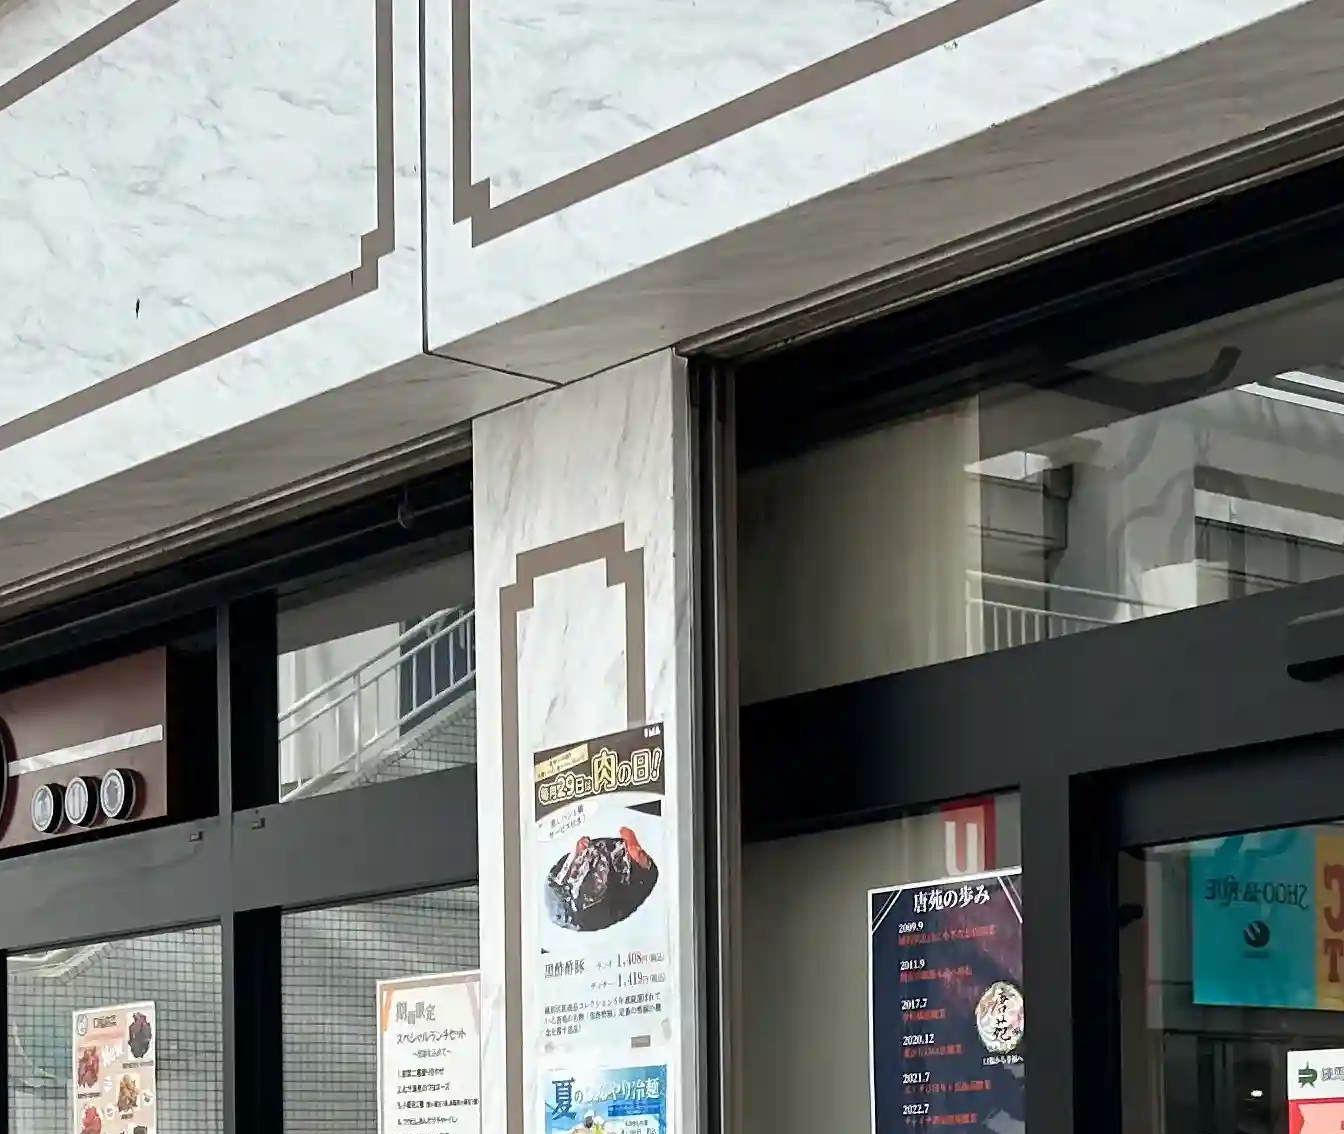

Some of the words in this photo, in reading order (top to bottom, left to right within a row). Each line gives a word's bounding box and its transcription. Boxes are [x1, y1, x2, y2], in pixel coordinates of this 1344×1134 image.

[913, 884, 991, 914] 唐苑の歩み
[898, 921, 925, 934] 2009.9
[899, 958, 926, 971] 2011.9
[901, 998, 929, 1011] 2017.7
[902, 1033, 936, 1046] 2020.12
[902, 1071, 932, 1084] 2021.7
[902, 1103, 931, 1116] 2022.7
